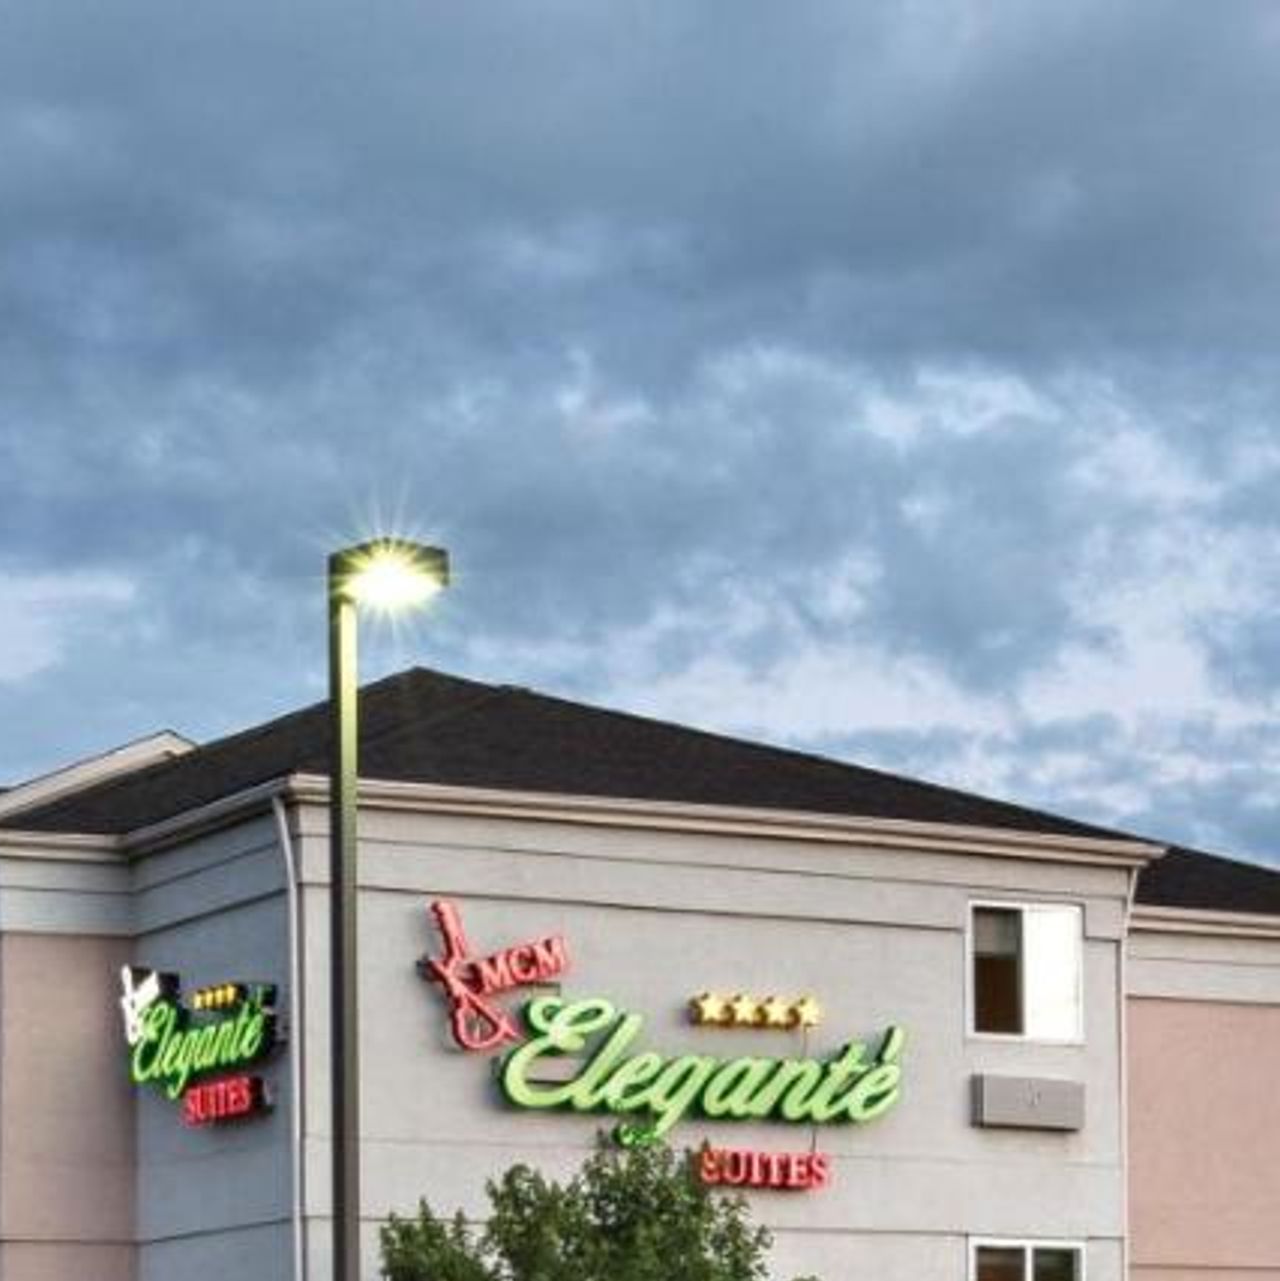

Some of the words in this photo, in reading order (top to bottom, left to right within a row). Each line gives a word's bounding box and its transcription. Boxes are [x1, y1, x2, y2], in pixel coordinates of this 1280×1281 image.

[478, 935, 567, 993] MCM
[133, 985, 264, 1099] Eleganté
[504, 997, 904, 1142] Eleganté
[184, 1077, 251, 1125] SUITES
[697, 1147, 832, 1189] SUITES
